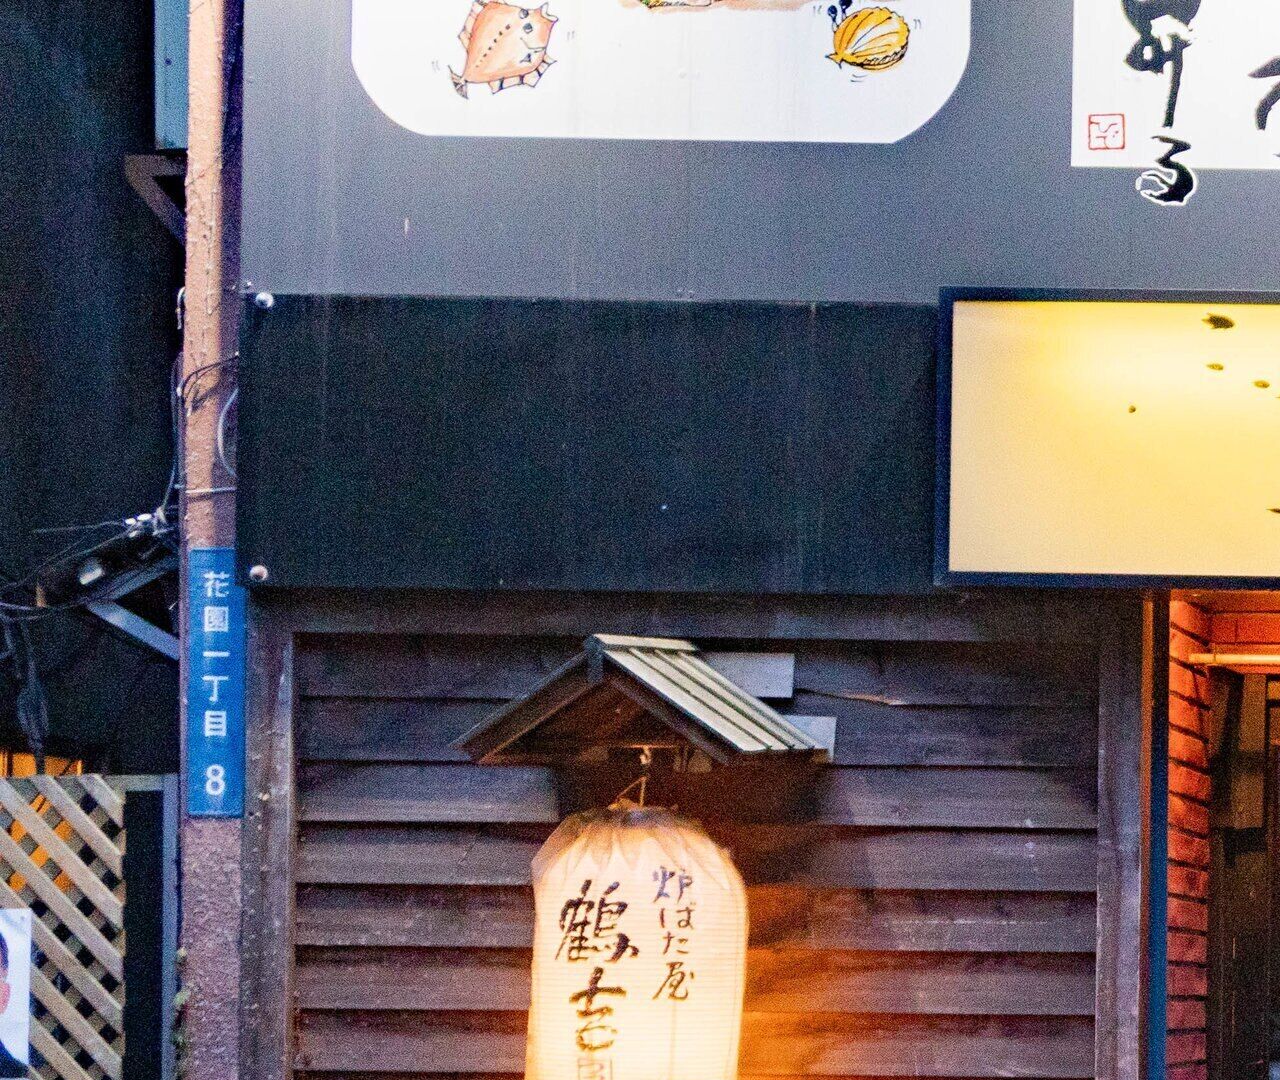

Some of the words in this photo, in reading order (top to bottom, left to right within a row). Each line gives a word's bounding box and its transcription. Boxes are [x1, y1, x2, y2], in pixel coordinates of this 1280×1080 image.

[203, 571, 230, 737] 花園一丁目
[205, 764, 226, 796] 8
[555, 879, 641, 1052] 鶴吉
